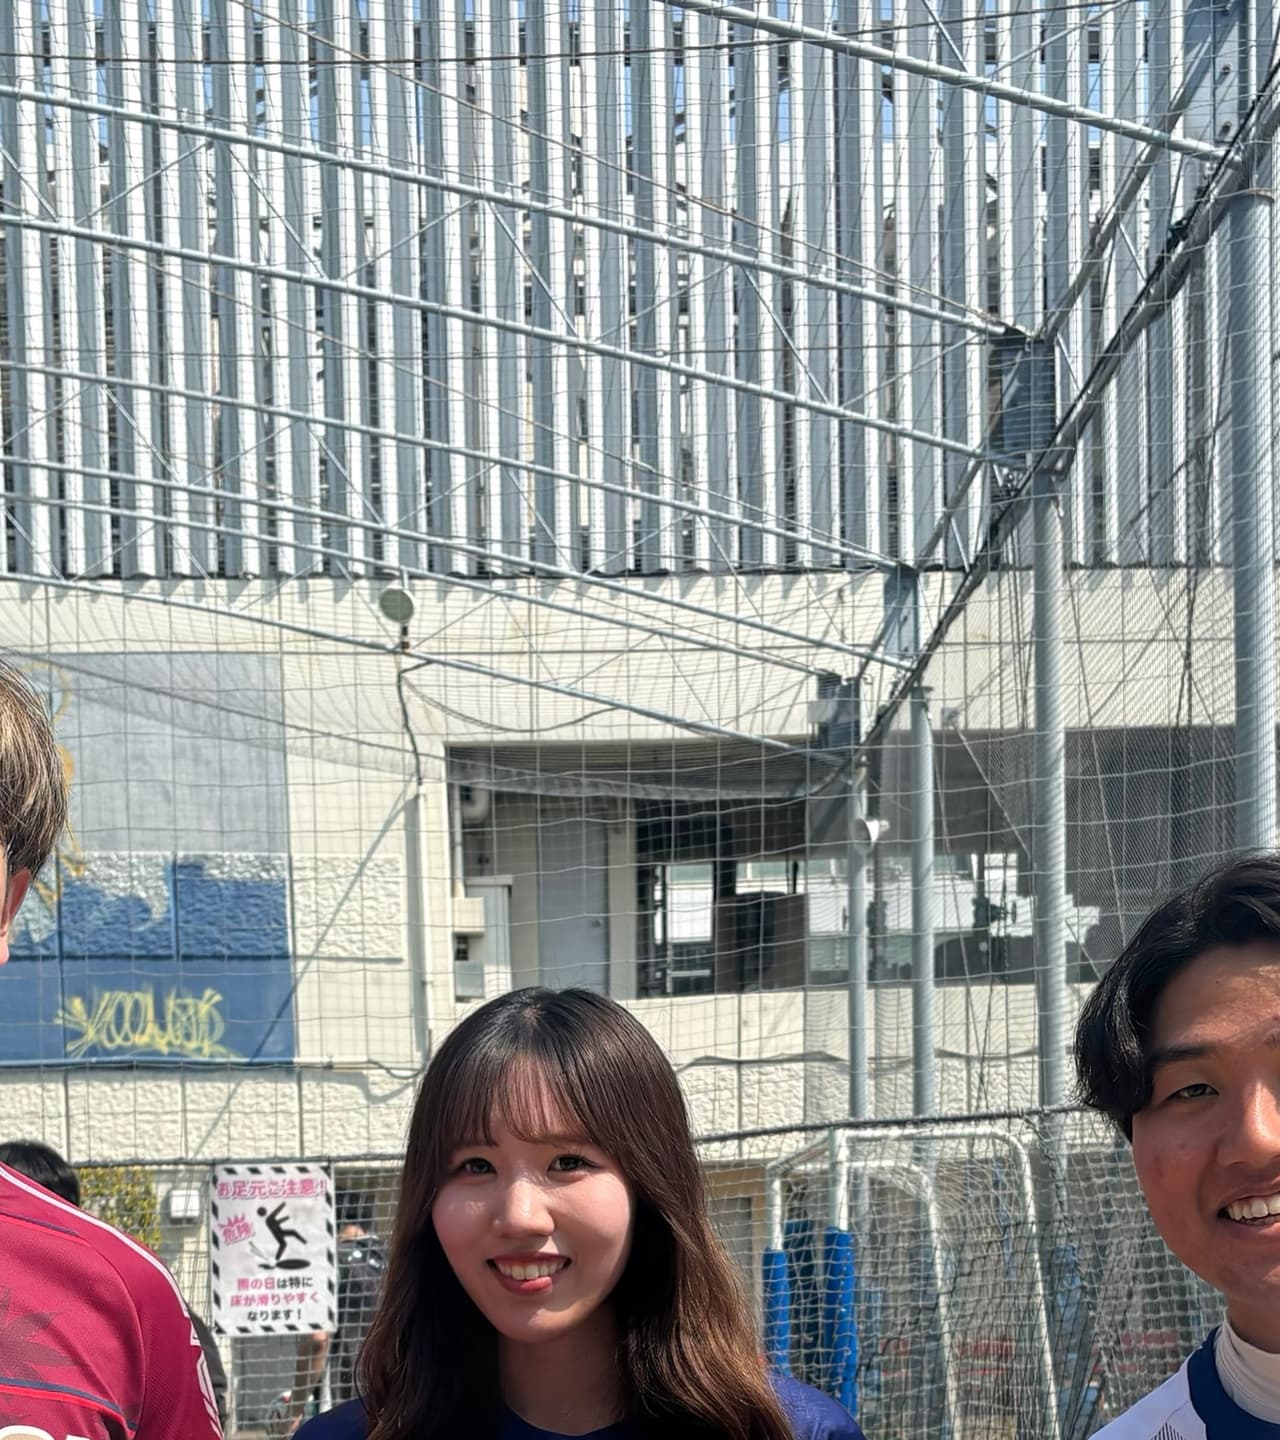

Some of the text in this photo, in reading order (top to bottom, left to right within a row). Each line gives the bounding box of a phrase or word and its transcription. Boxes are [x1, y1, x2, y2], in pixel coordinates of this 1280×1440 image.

[230, 1292, 320, 1307] 床が滑りやすく
